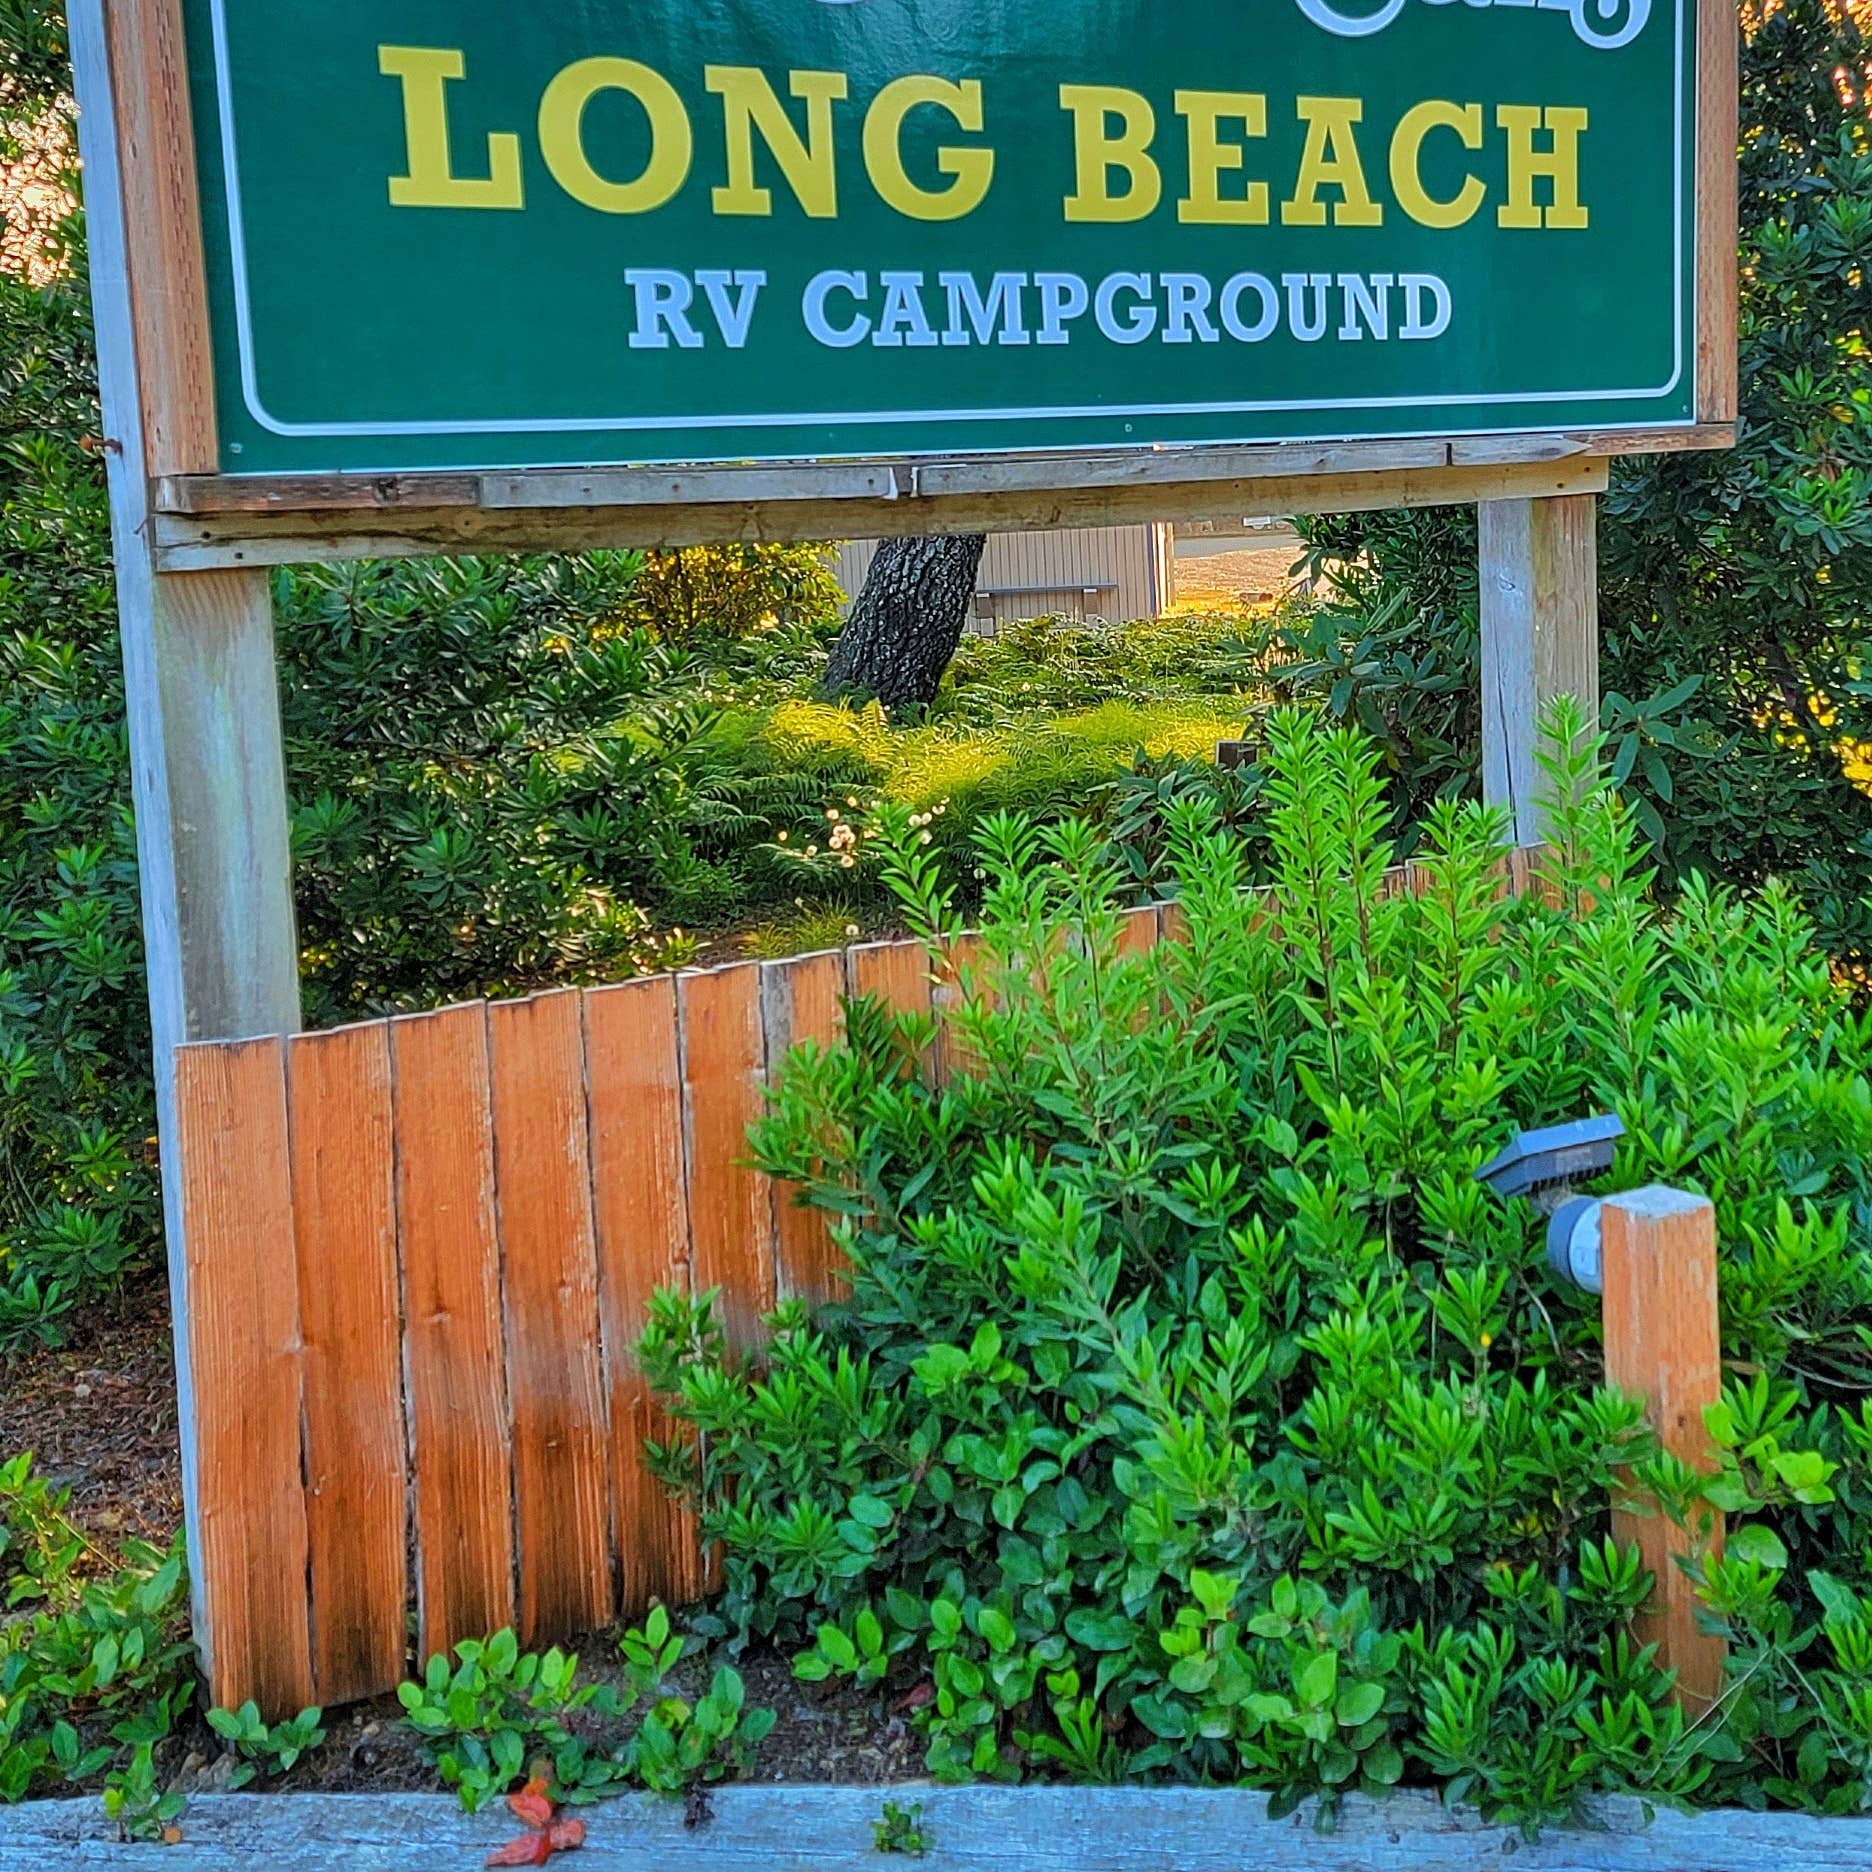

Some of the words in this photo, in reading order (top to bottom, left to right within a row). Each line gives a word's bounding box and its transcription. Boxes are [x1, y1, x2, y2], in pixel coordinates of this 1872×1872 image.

[378, 44, 996, 222] LONG
[1058, 83, 1590, 230] BEACH
[624, 268, 767, 350] RV
[802, 270, 1453, 347] CAMPGROUND
